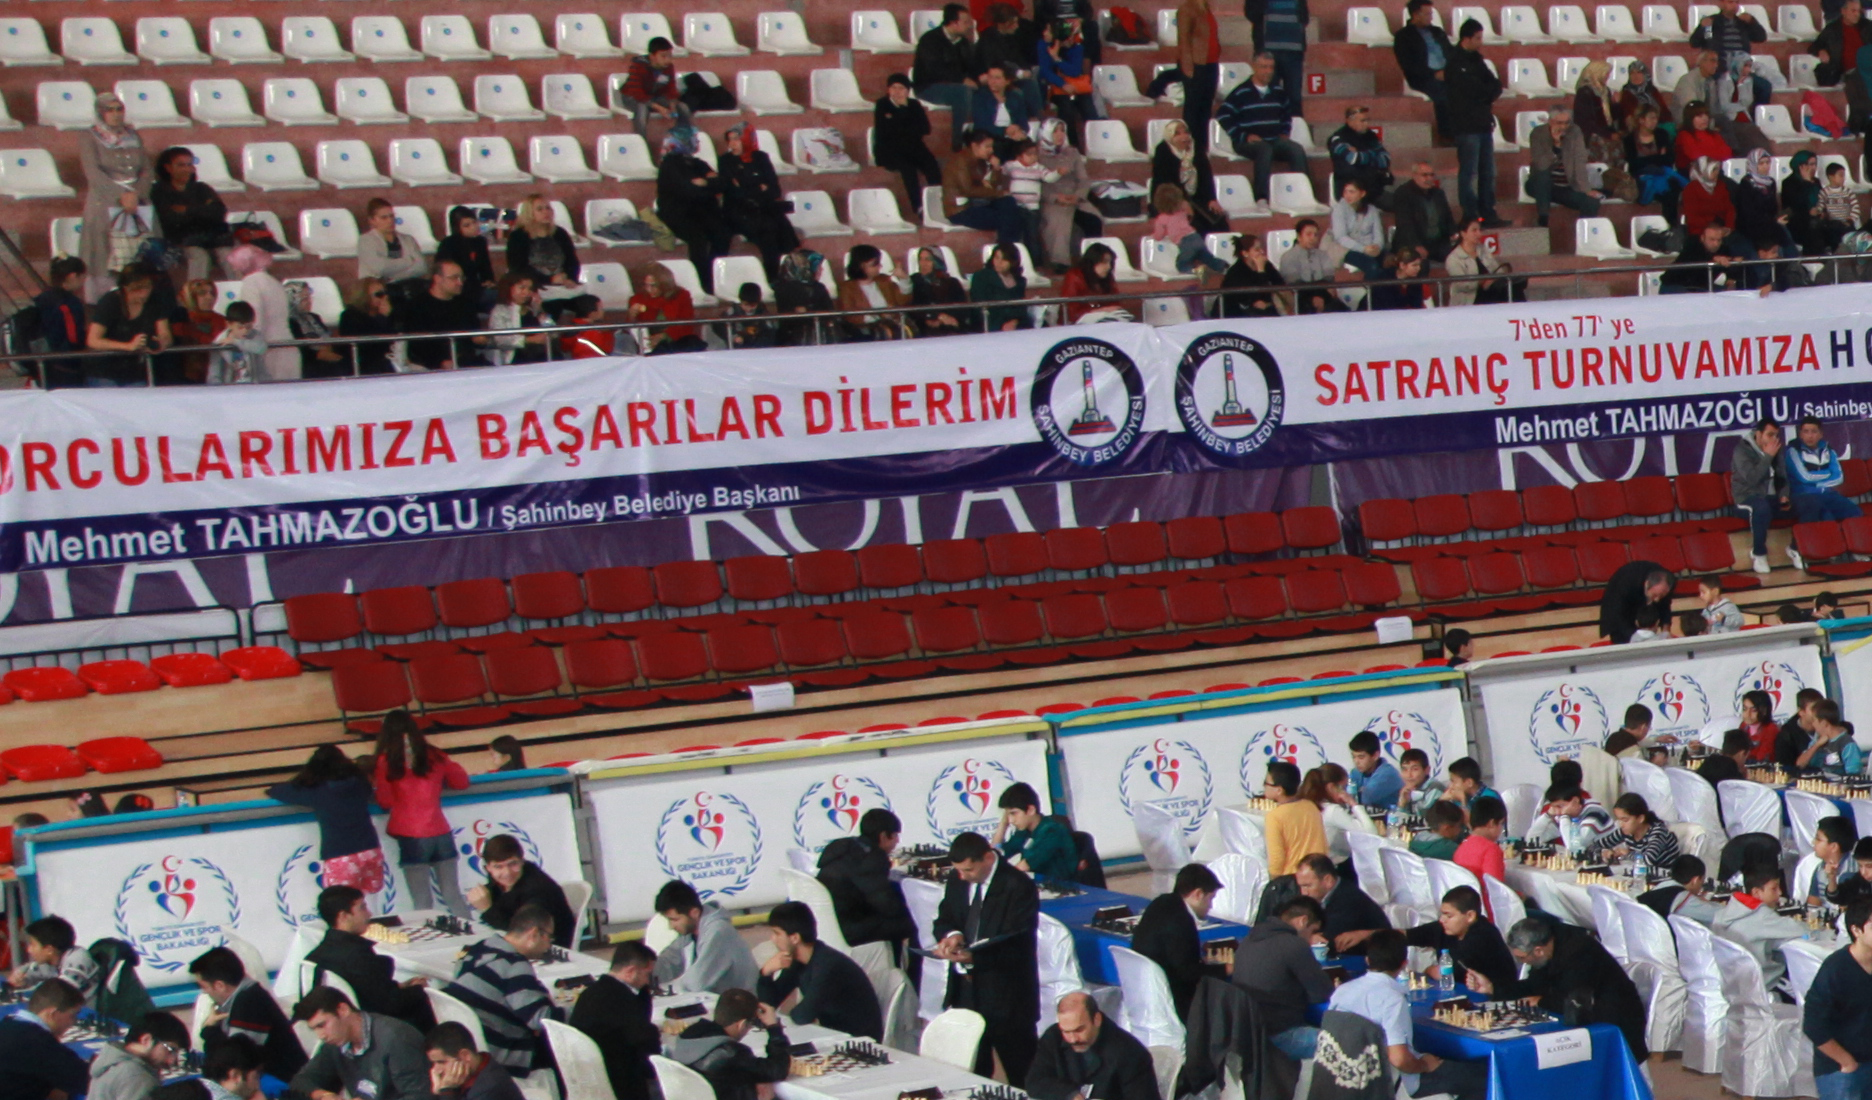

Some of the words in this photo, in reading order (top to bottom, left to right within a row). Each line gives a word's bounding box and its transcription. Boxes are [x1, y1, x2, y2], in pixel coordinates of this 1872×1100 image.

[1311, 75, 1321, 92] F
[1508, 318, 1568, 341] 7'den
[1572, 315, 1603, 337] 77'
[1610, 318, 1636, 340] ye
[1314, 352, 1510, 406] SATRANÇ
[1523, 333, 1820, 390] TURNUVAMIZA
[478, 393, 784, 467] BAŞARILAR
[806, 367, 1018, 437] DİLERİM
[1495, 412, 1600, 443] Mehmet
[25, 517, 187, 566] Mehmet
[197, 494, 478, 550] TAHMAZOĞLU
[501, 497, 607, 531] Şahinbey
[614, 489, 708, 519] Belediye
[714, 483, 801, 513] Başkanı
